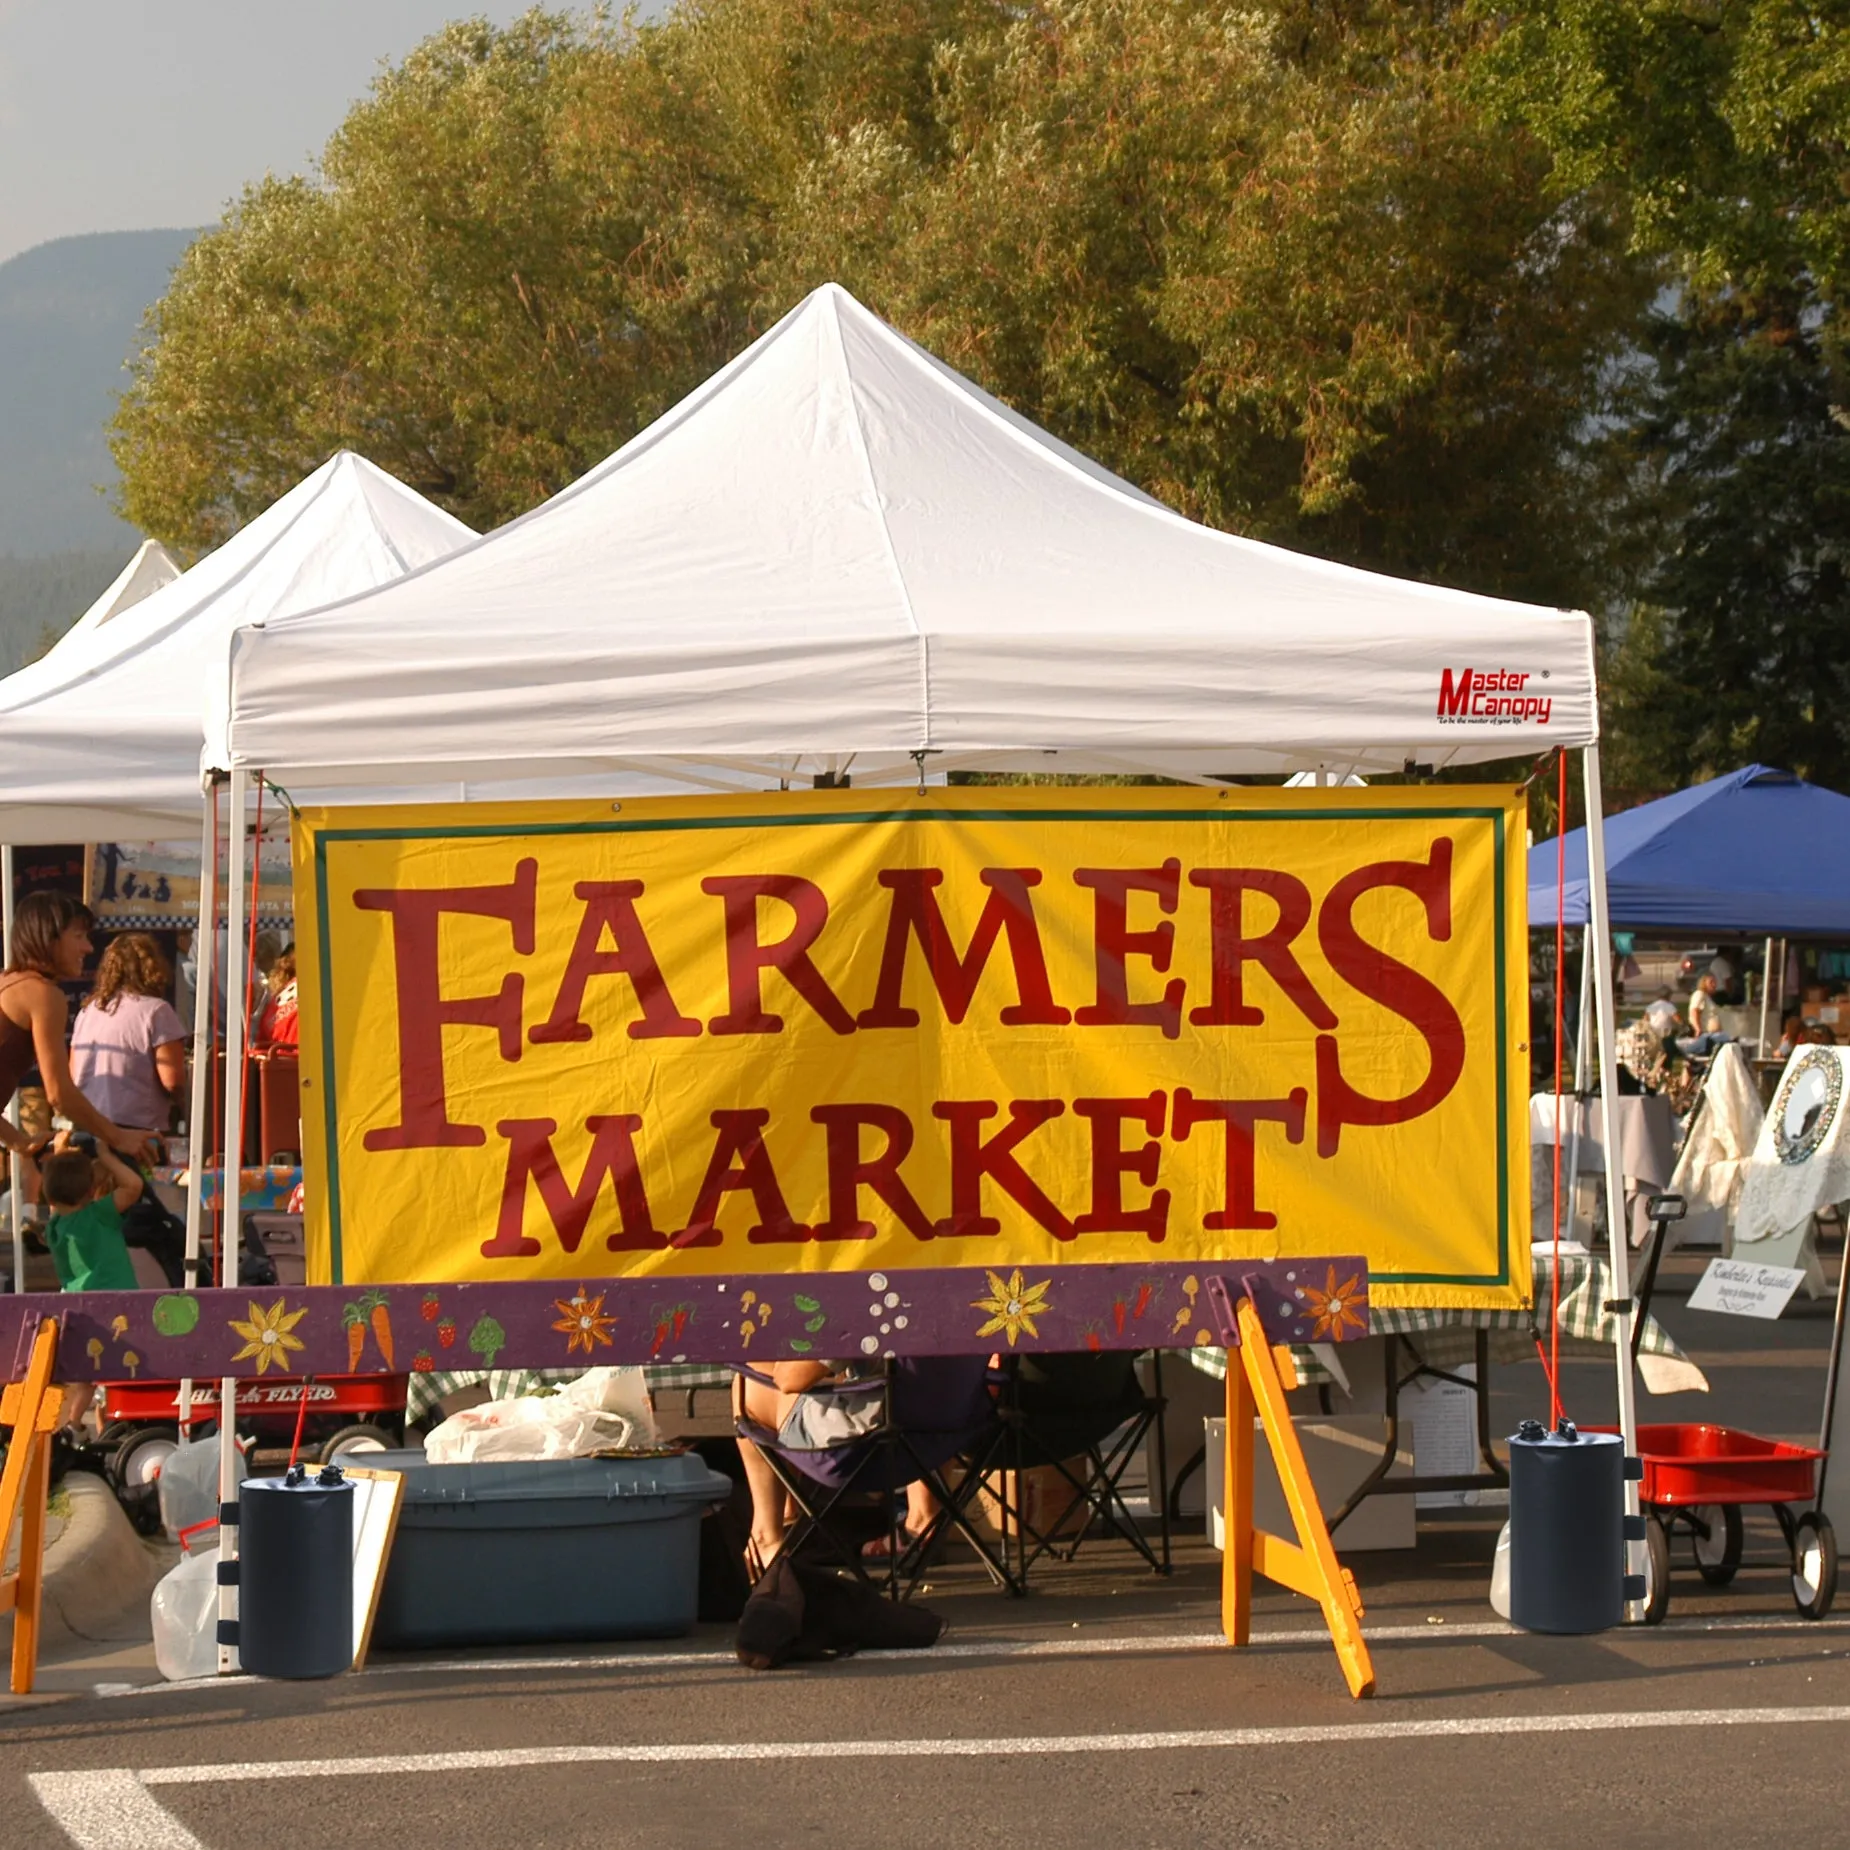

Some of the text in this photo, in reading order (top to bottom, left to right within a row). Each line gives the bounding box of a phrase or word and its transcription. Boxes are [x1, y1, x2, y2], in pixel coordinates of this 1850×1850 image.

[1471, 693, 1552, 724] Canopy
[353, 837, 1466, 1158] FARMERS
[480, 1087, 1308, 1259] MARKET
